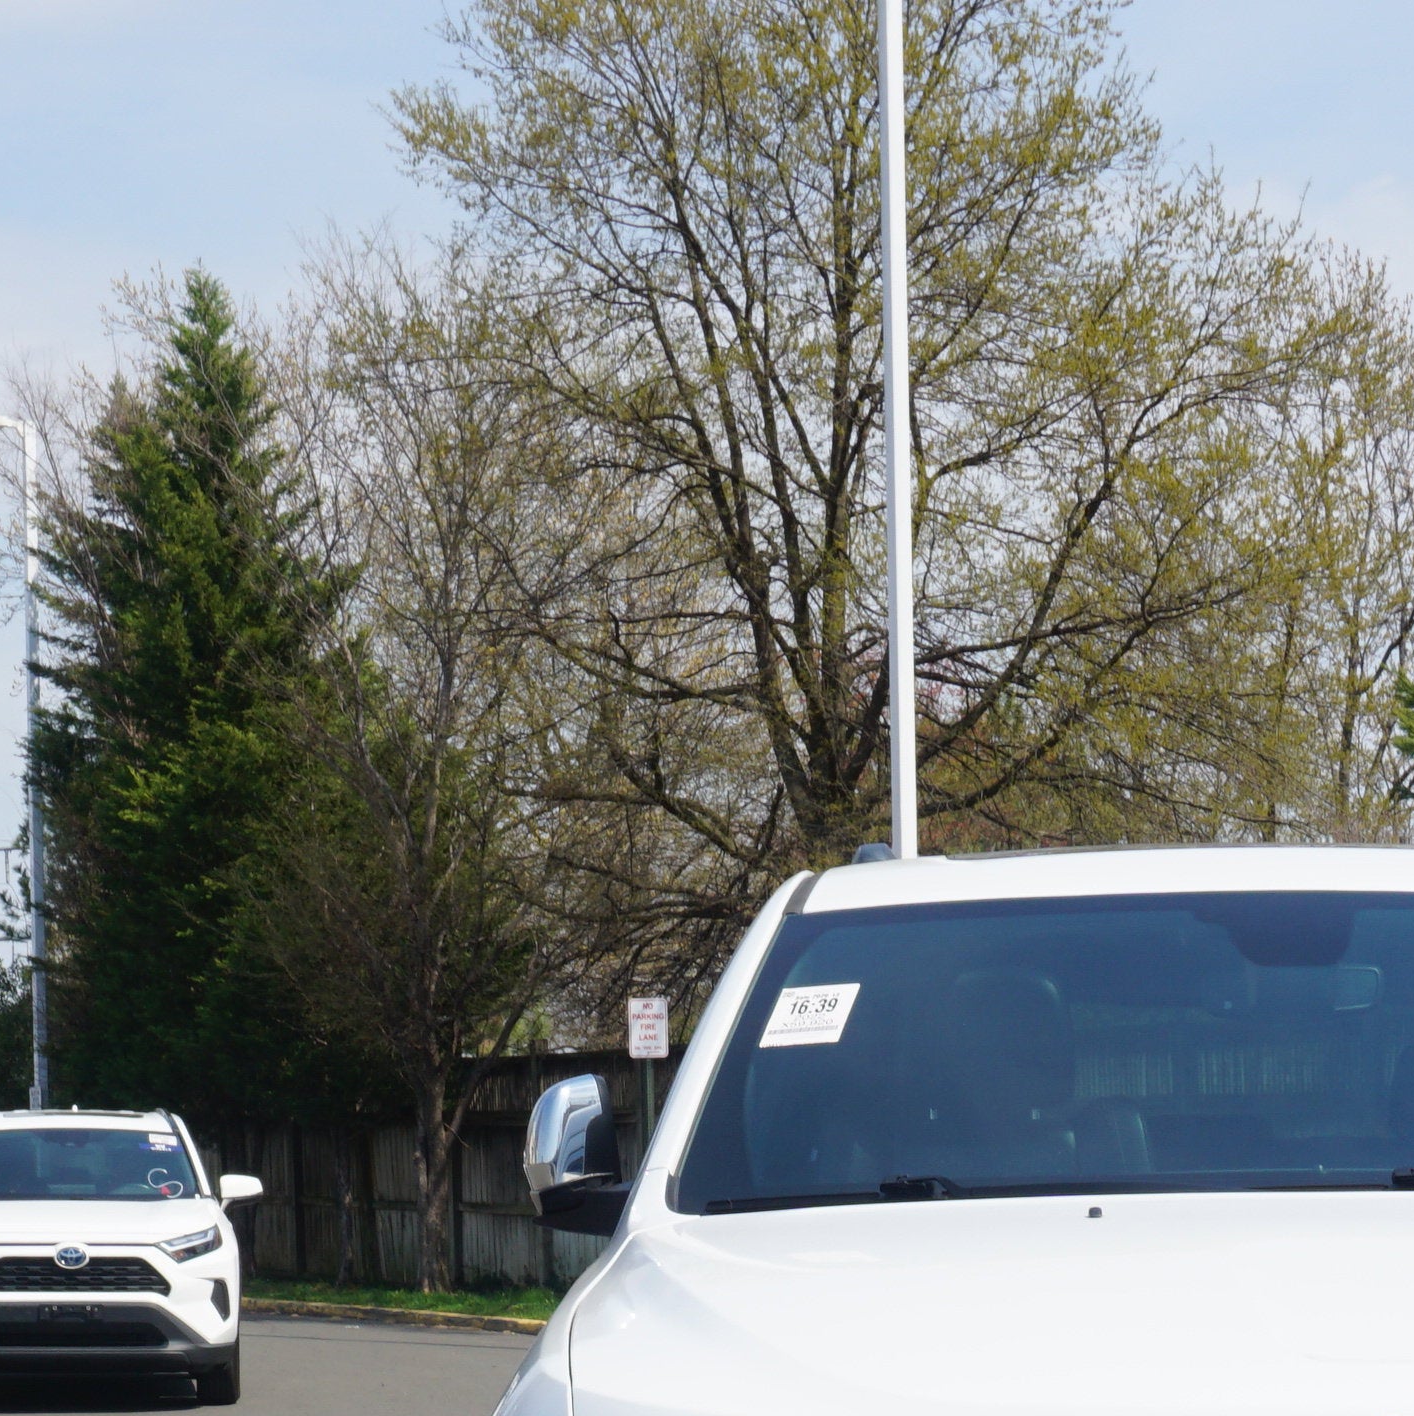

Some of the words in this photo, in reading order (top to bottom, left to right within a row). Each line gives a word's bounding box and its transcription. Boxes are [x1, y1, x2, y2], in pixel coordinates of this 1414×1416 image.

[642, 1002, 653, 1010] NO
[790, 997, 839, 1015] 16:39
[632, 1012, 664, 1020] PARKING
[640, 1023, 657, 1031] FIRE
[638, 1033, 658, 1041] LANE
